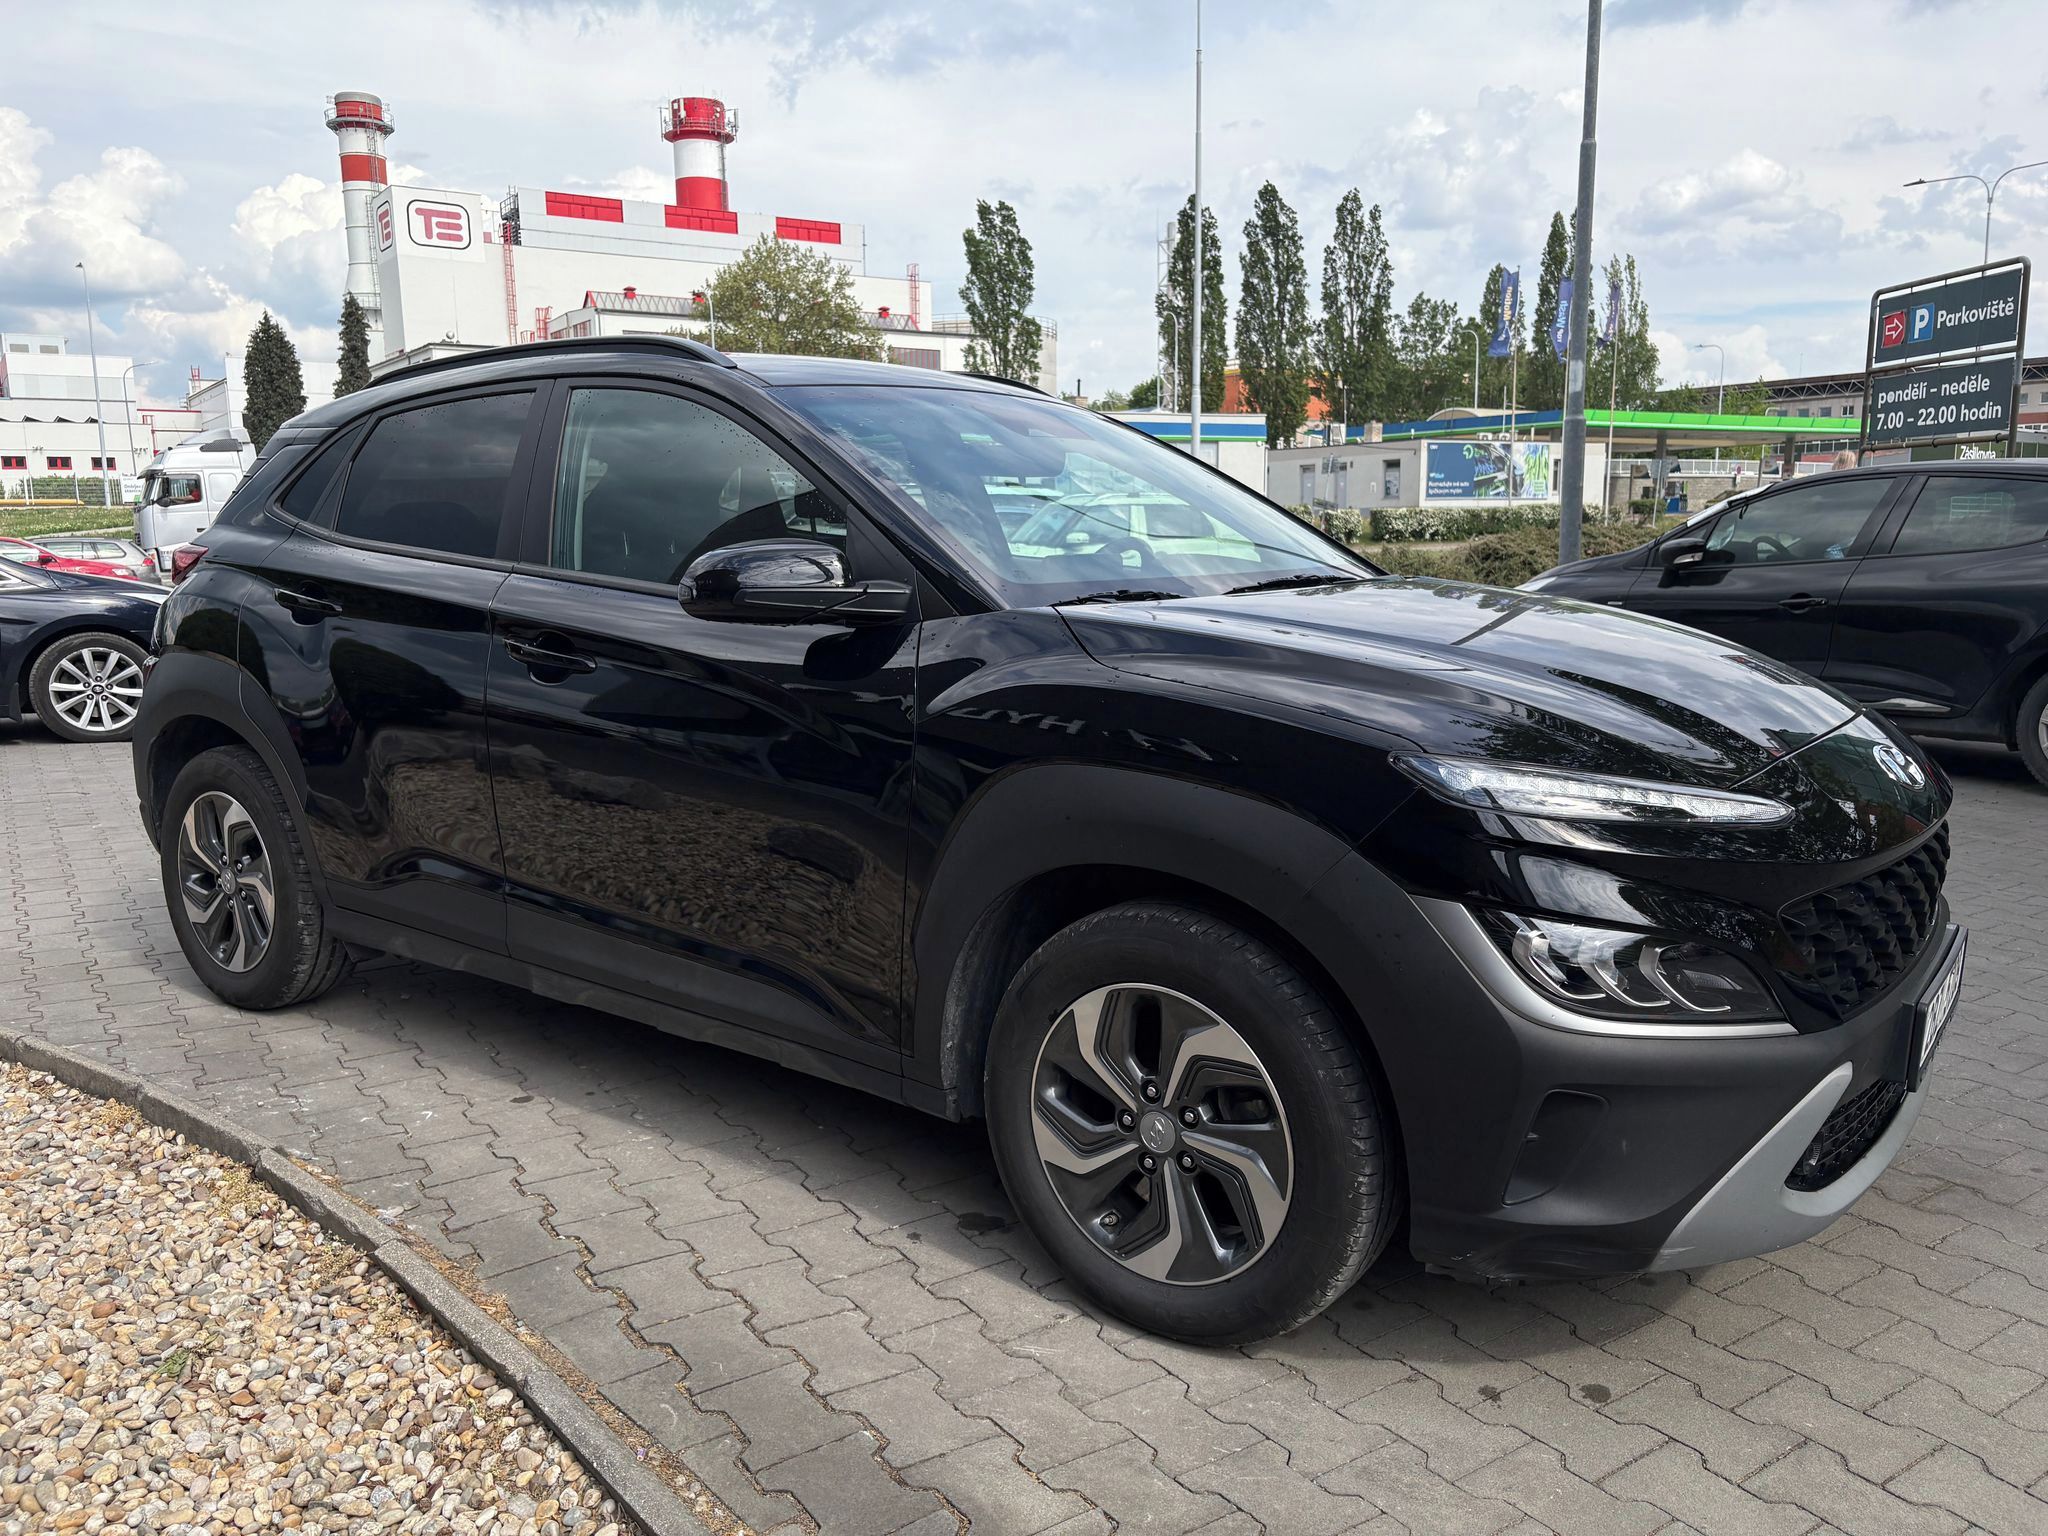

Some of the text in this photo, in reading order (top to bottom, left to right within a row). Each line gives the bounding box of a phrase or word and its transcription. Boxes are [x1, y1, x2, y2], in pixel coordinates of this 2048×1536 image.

[1913, 297, 2015, 339] P Parkoviště
[1878, 382, 1928, 408] pondělí
[1941, 374, 1990, 396] neděle
[1876, 411, 1904, 430] 7.00
[1917, 405, 1956, 426] 22.00
[1960, 401, 2002, 422] hodin
